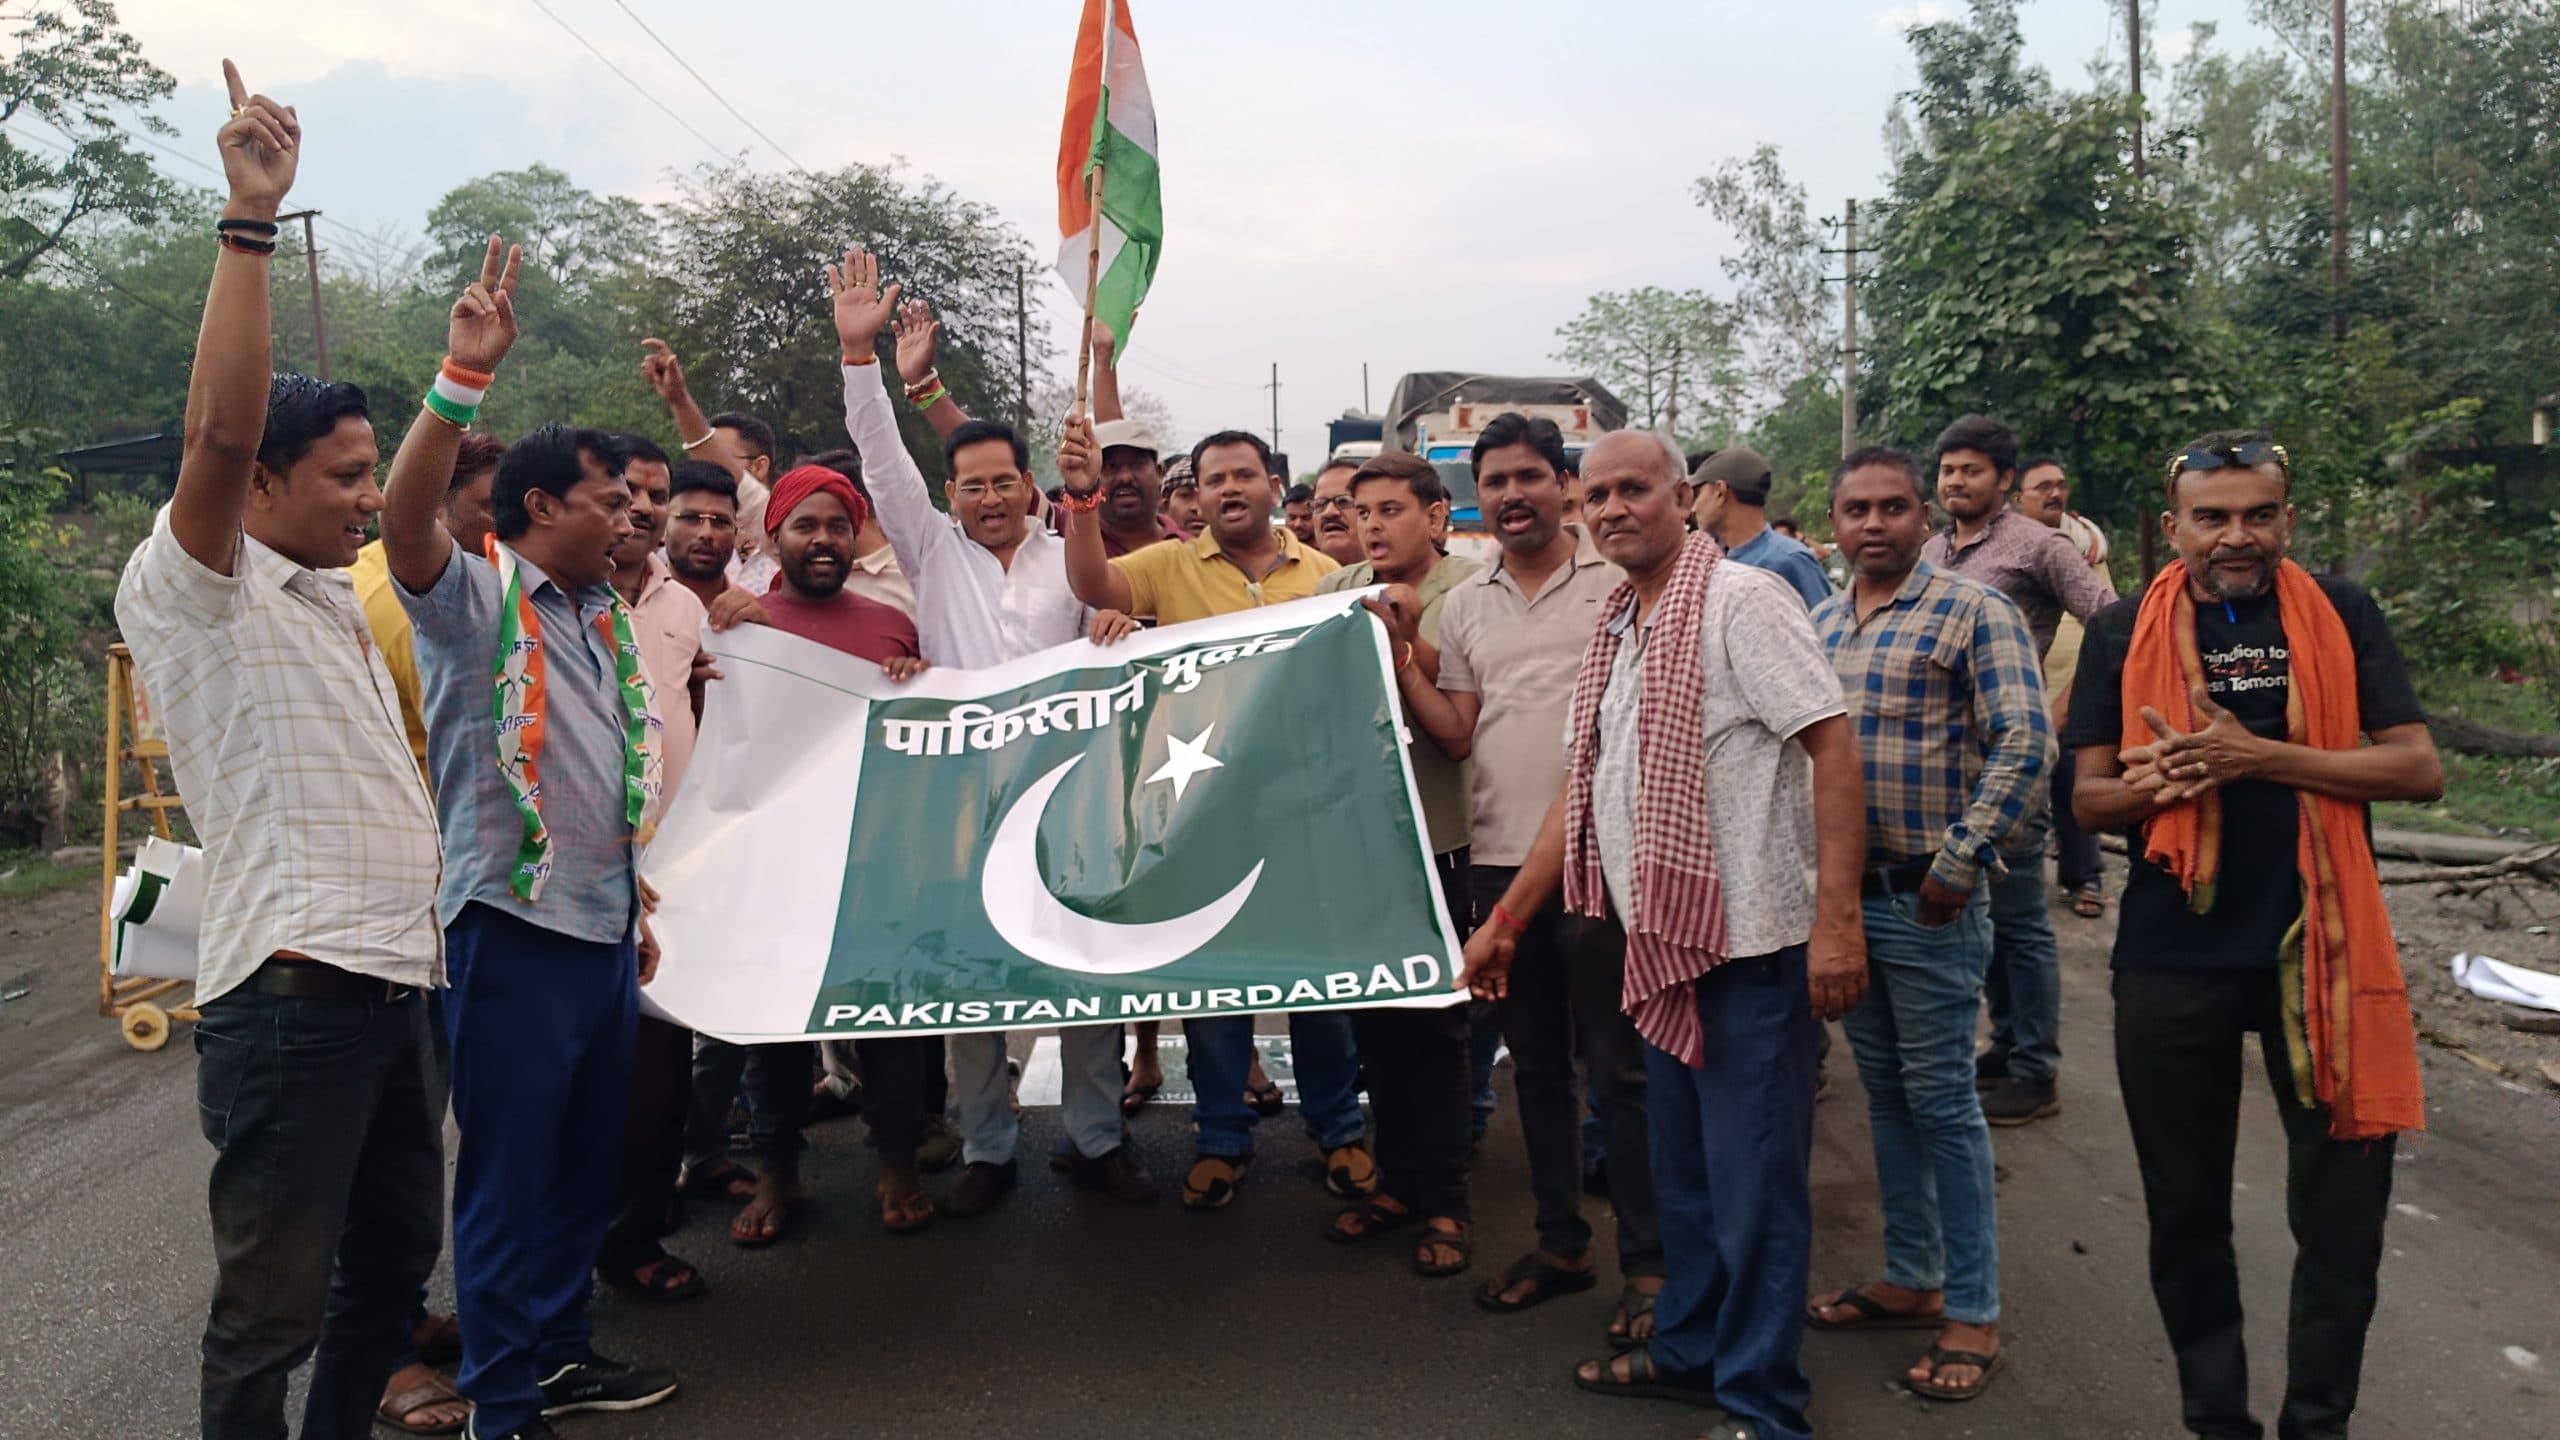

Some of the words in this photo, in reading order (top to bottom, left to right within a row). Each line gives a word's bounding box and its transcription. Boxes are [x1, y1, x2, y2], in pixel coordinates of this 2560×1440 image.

[882, 669, 1148, 757] पाकिस्तान
[824, 997, 1100, 1027] PAKISTAN
[1120, 953, 1441, 1015] MURDABAD
